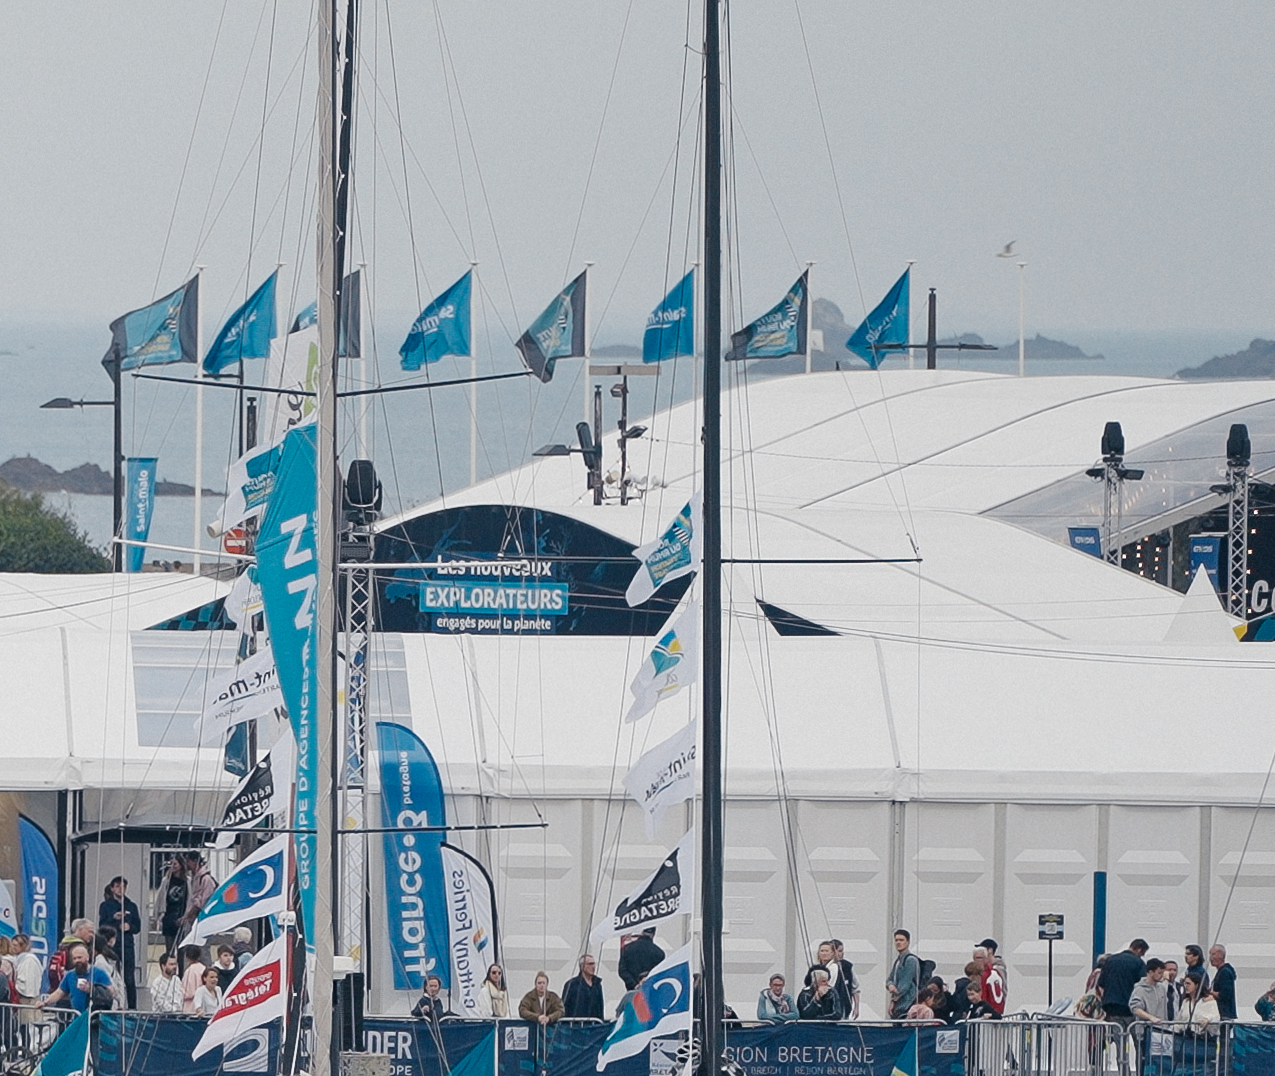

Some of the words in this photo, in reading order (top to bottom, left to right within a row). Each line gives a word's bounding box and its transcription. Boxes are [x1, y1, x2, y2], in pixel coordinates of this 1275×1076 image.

[425, 587, 563, 609] EXPLORATEURS
[436, 617, 476, 631] engagés
[478, 621, 500, 631] pour
[503, 617, 513, 629] la
[514, 617, 551, 631] planète
[298, 813, 311, 890] GROUPE
[722, 1047, 768, 1063] GION
[778, 1047, 874, 1063] BRETAGNE
